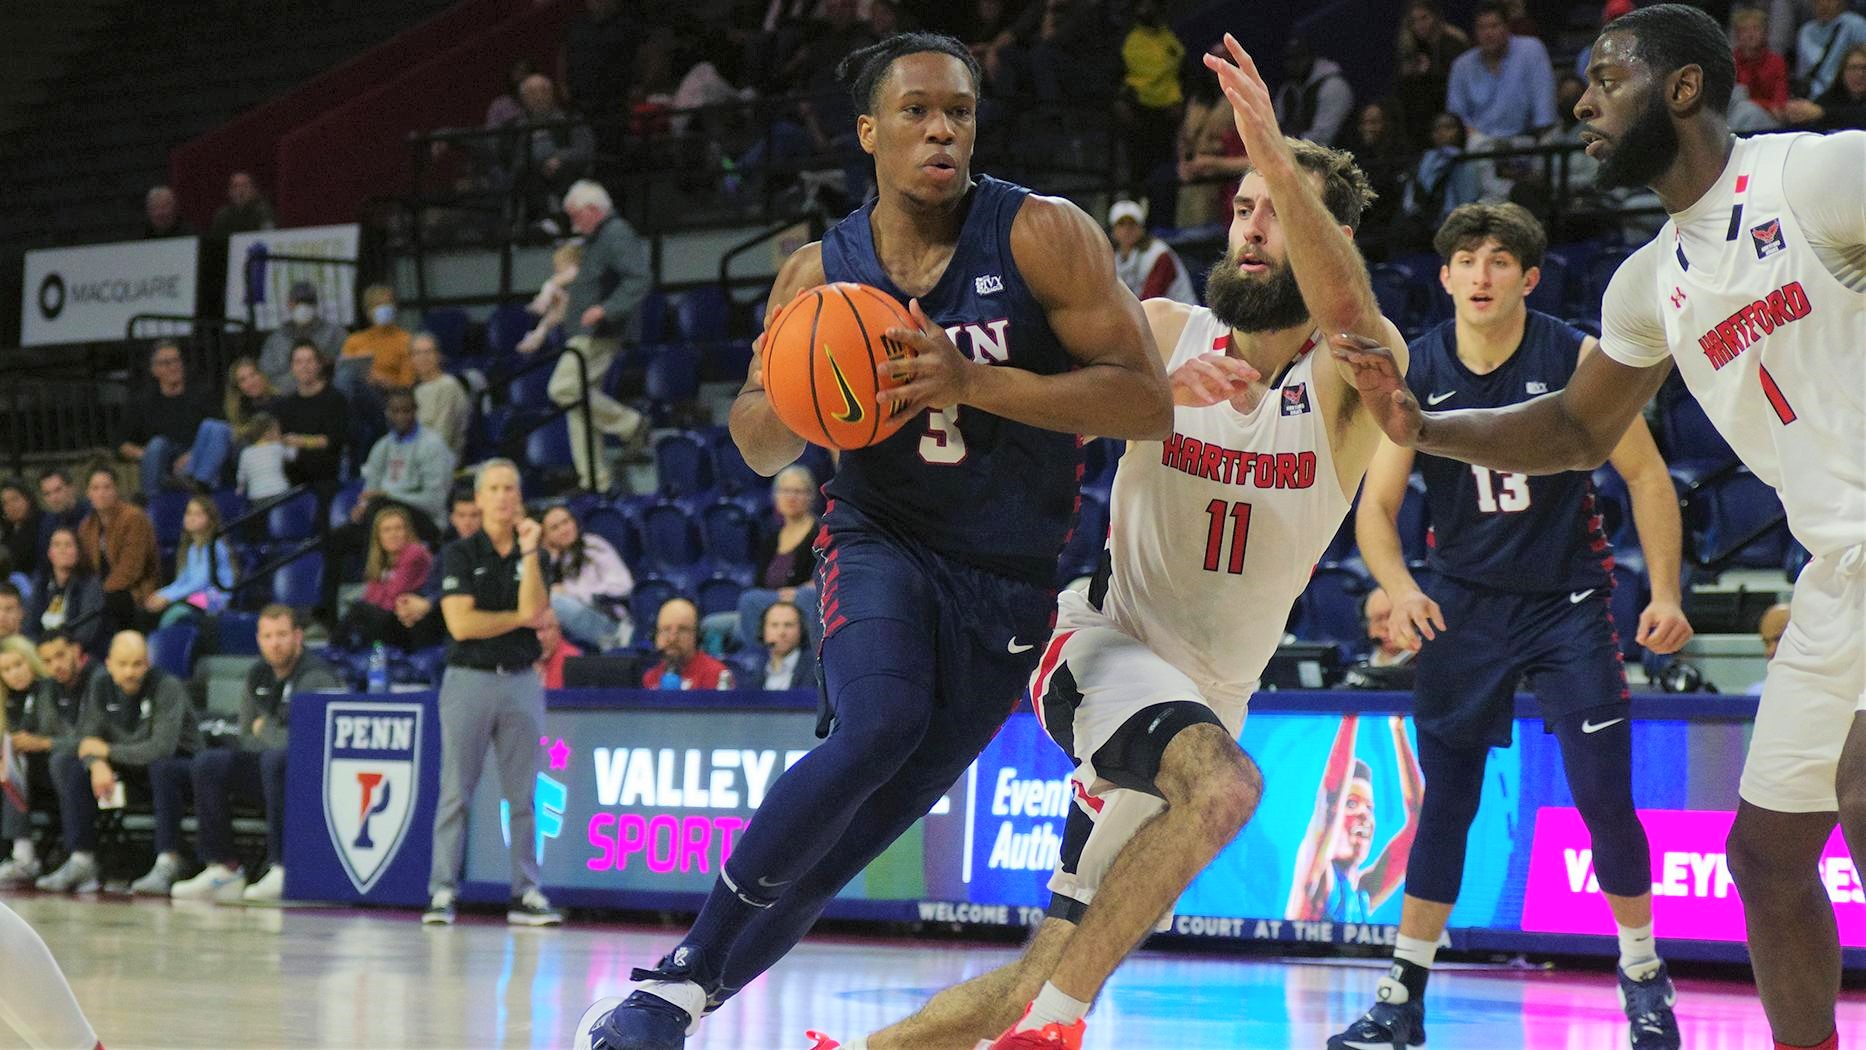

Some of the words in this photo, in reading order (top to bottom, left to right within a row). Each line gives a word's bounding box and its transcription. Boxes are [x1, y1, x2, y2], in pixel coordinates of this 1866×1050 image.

[71, 273, 181, 303] MACQUARIE
[1698, 280, 1812, 371] HARTFORD
[1759, 361, 1798, 426] 1
[917, 405, 968, 464] 3
[1162, 432, 1317, 489] HARTFORD
[1471, 464, 1532, 513] 13
[1203, 498, 1252, 575] 11
[334, 715, 415, 750] PENN
[593, 747, 776, 809] VALLEY
[353, 772, 391, 848] P
[586, 811, 753, 874] SPORT
[918, 902, 1008, 925] WELCOME
[1017, 906, 1045, 926] TO
[1176, 915, 1244, 936] COURT
[1253, 920, 1283, 940] AT
[1294, 921, 1334, 943] THE
